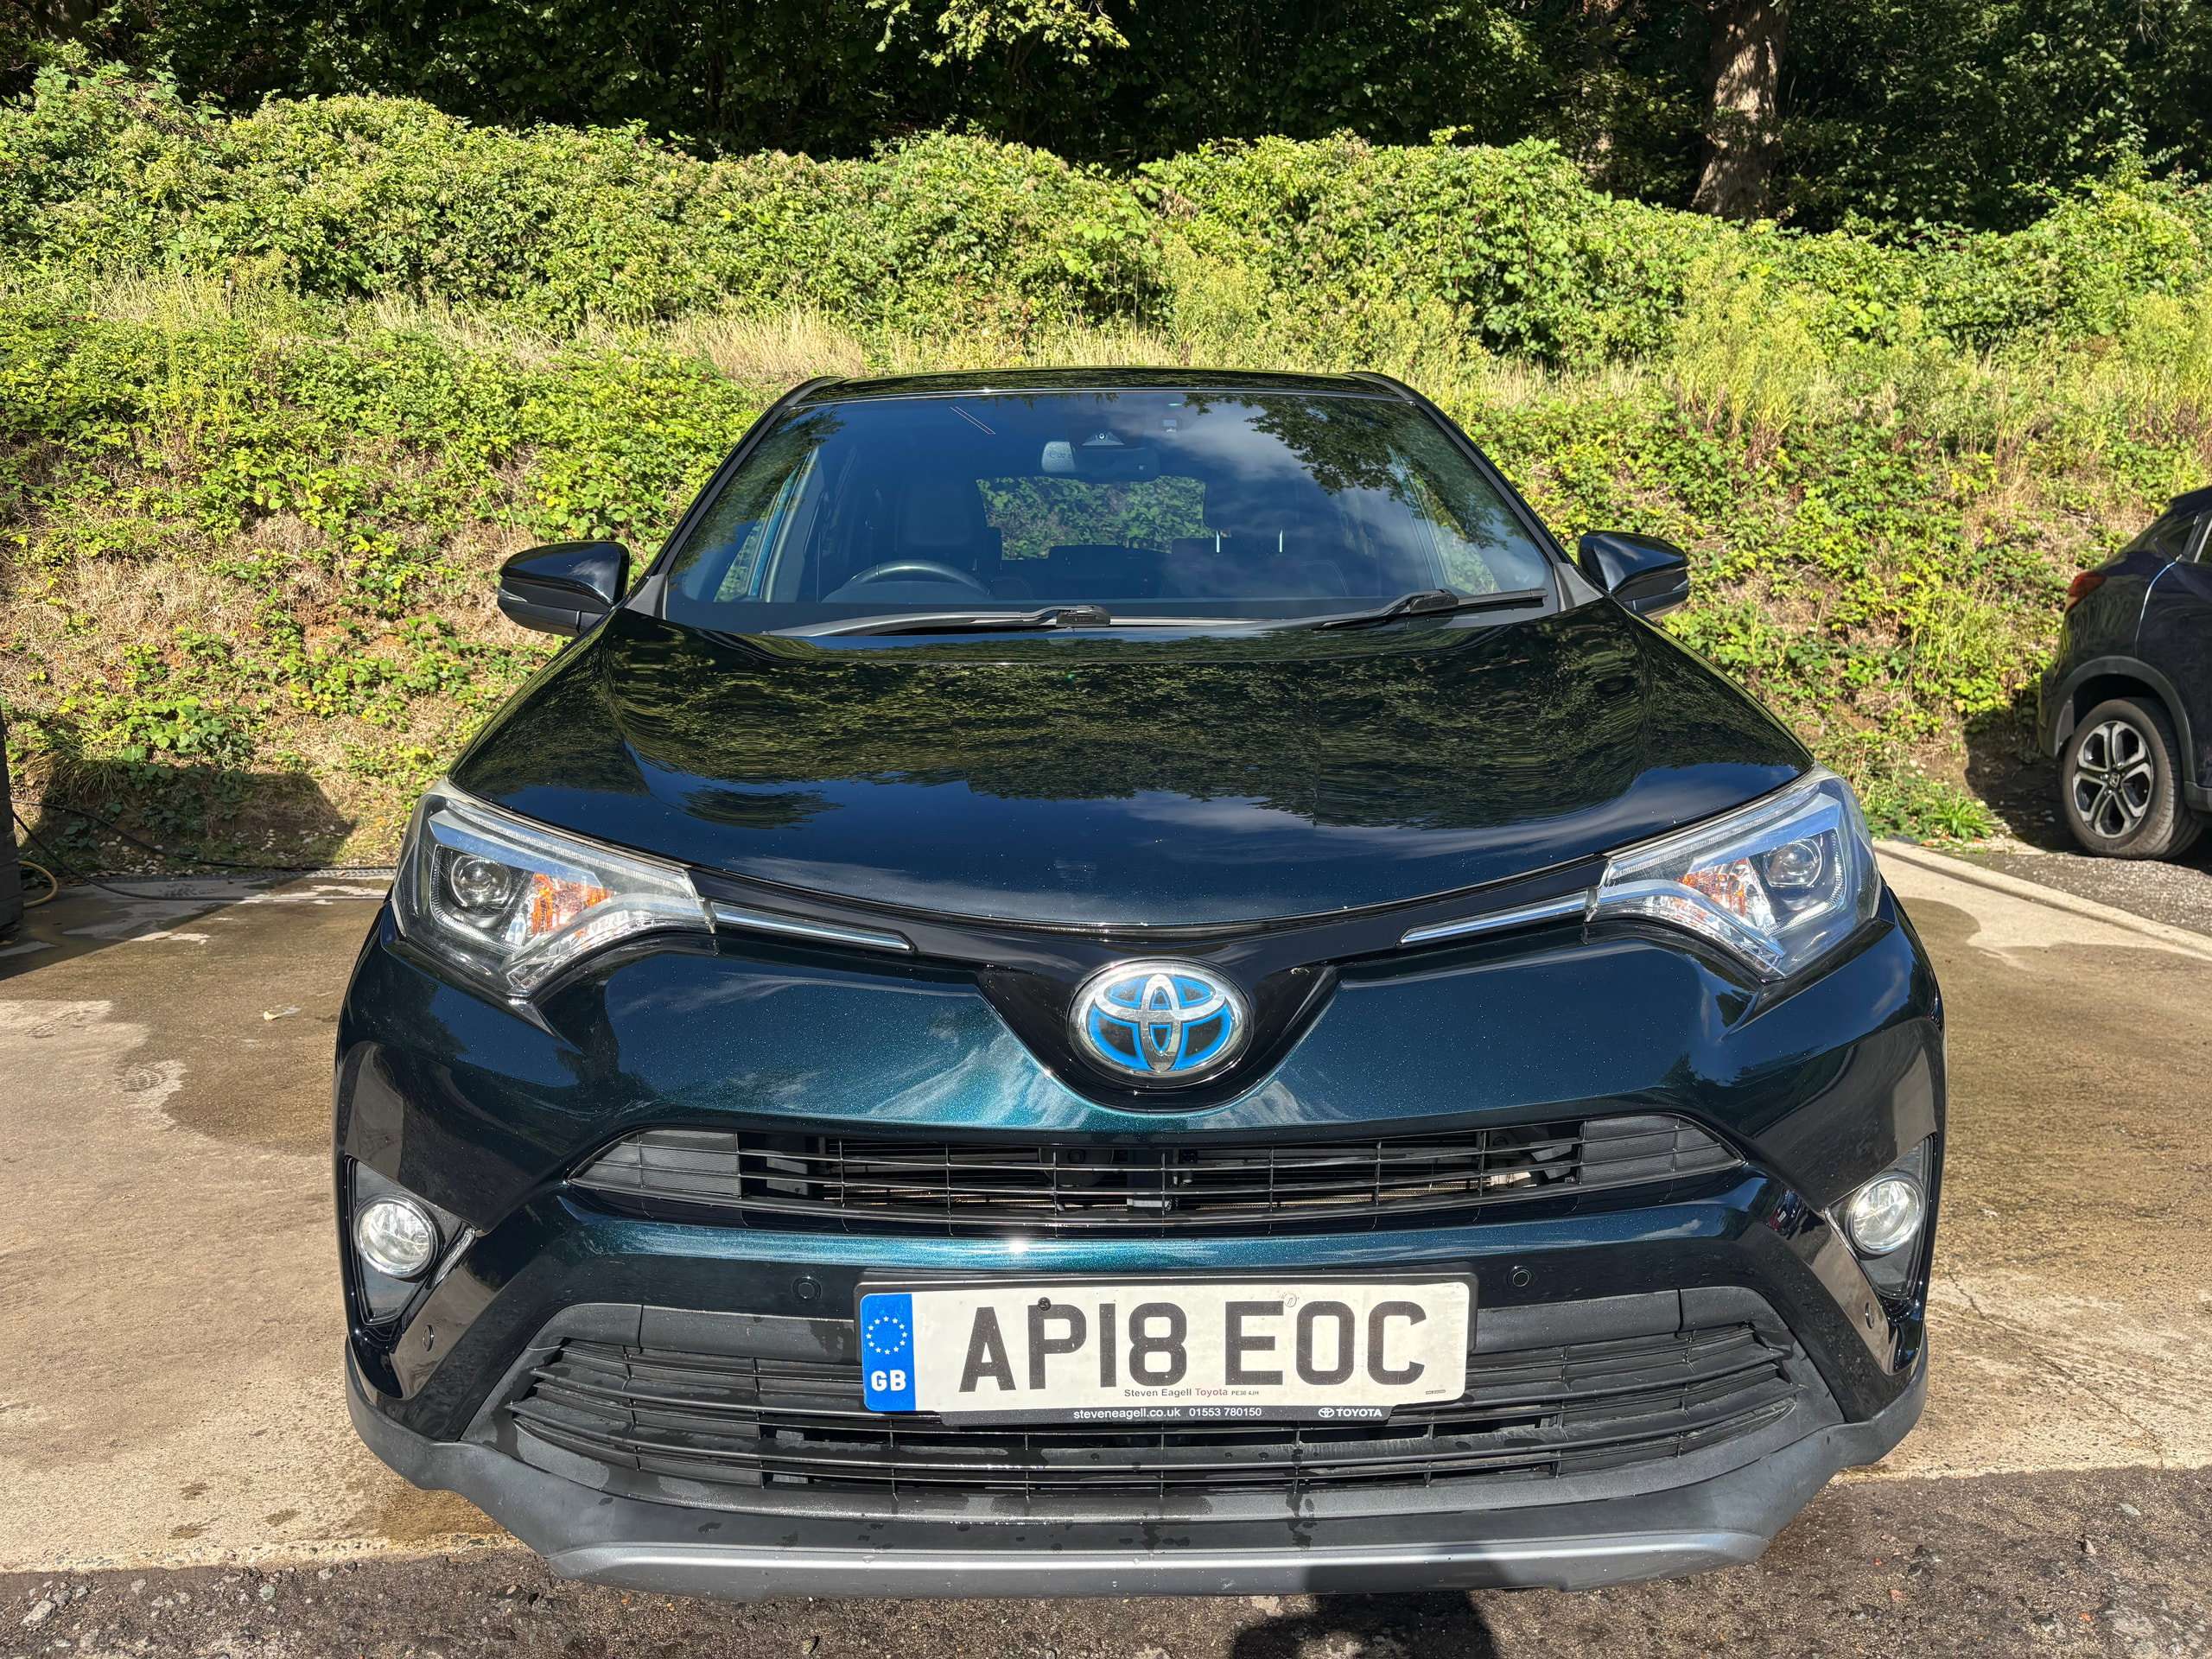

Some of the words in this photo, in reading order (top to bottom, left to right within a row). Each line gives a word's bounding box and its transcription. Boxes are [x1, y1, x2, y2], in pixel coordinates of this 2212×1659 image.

[958, 1302, 1187, 1392] AP18
[1225, 1300, 1427, 1385] EOC
[871, 1370, 906, 1391] GB
[1124, 1389, 1158, 1397] Steven
[1161, 1389, 1192, 1398] Eagell
[1195, 1388, 1228, 1398] Toyota
[1073, 1408, 1181, 1420] steveneagell.co.uk
[1189, 1408, 1221, 1417] 01553
[1224, 1408, 1262, 1417] 780150
